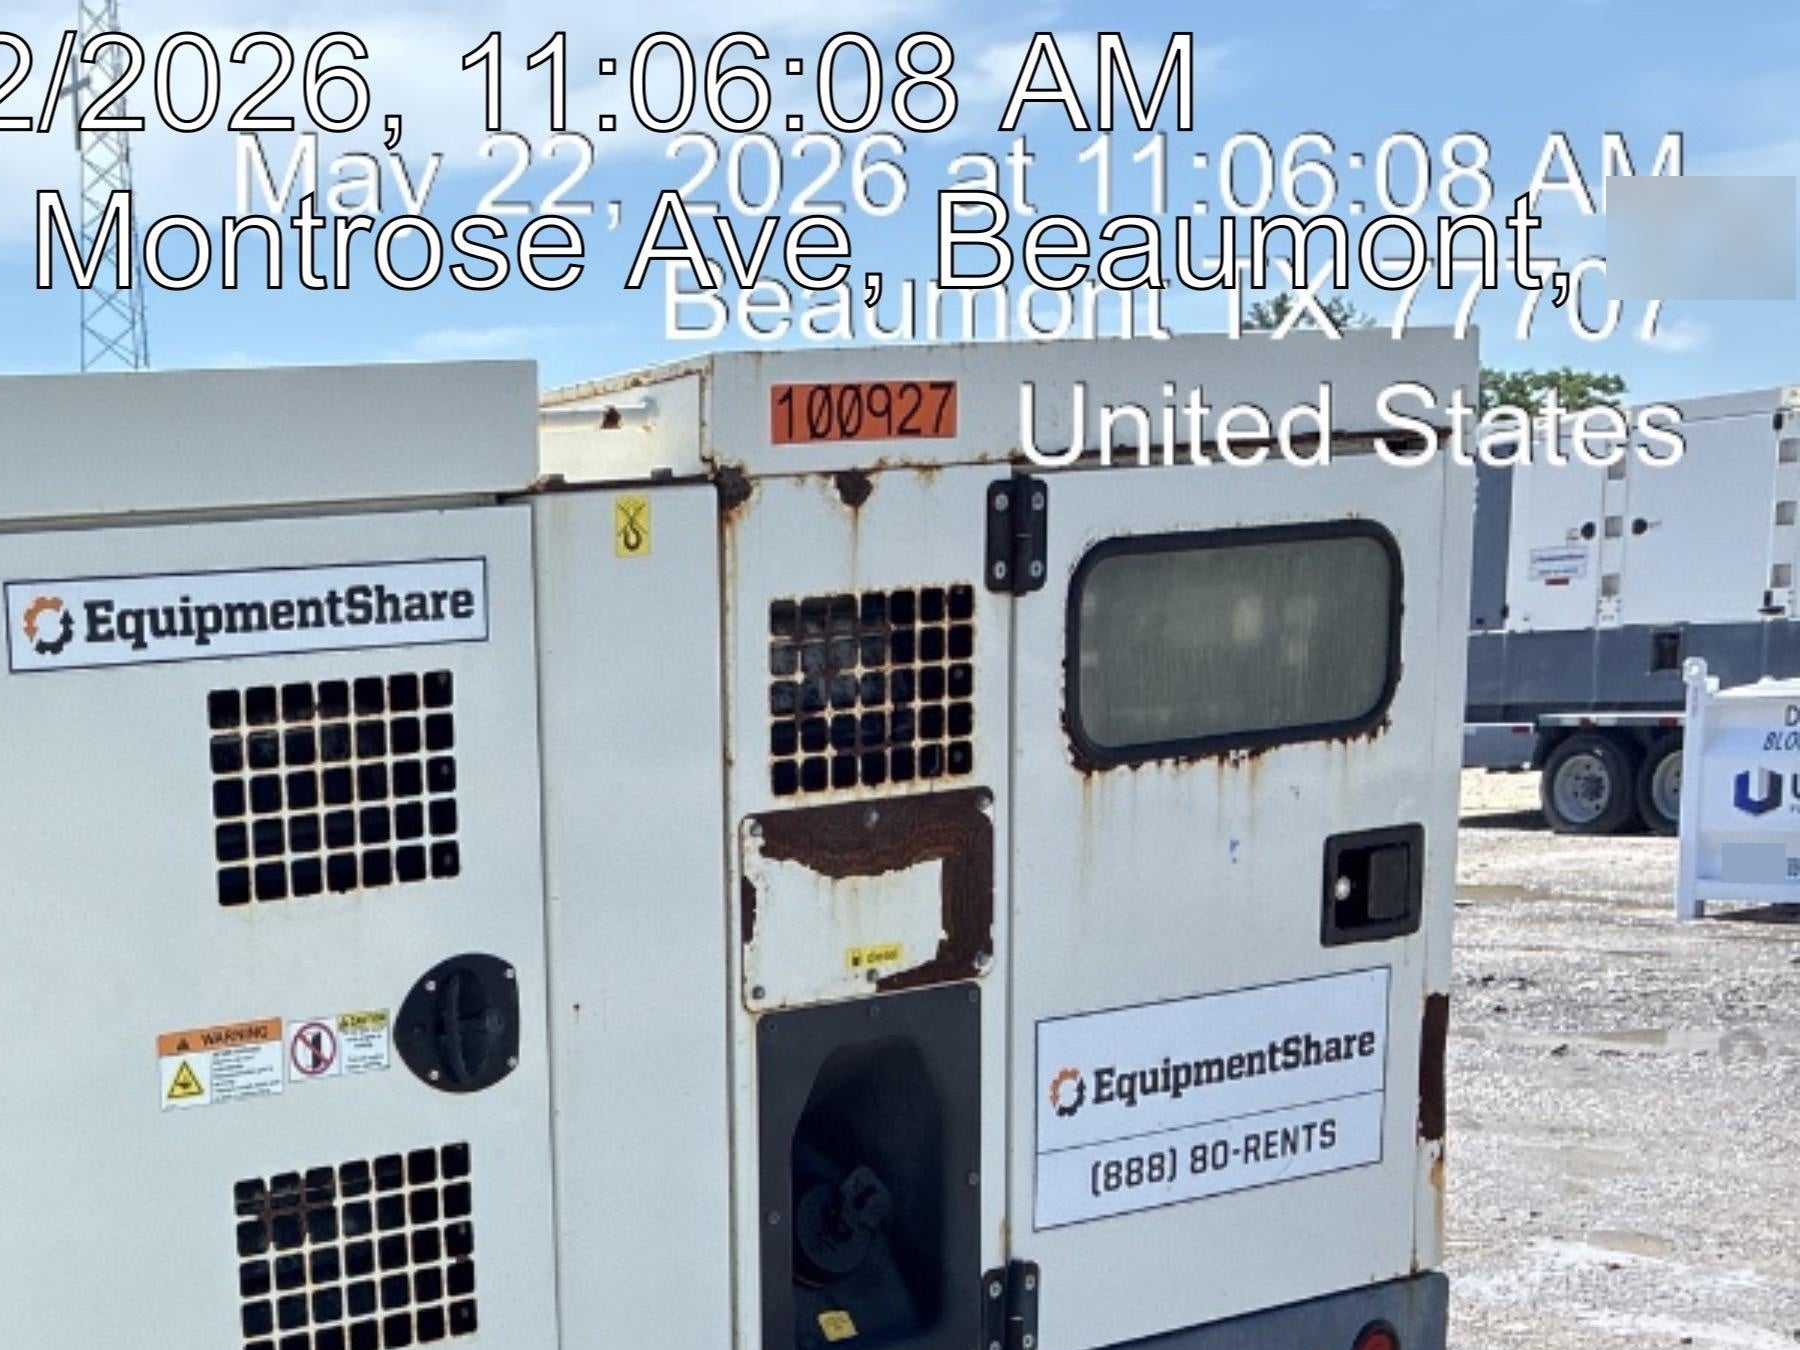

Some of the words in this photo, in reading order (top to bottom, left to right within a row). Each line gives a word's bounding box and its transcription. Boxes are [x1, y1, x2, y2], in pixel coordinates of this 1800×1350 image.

[776, 381, 956, 440] 100927
[83, 584, 475, 649] EquipmentShare
[201, 1025, 268, 1046] WARNING
[1091, 1030, 1376, 1106] EquipmentShare
[1090, 1148, 1177, 1197] (888)
[1190, 1119, 1337, 1174] 80-RENTS
